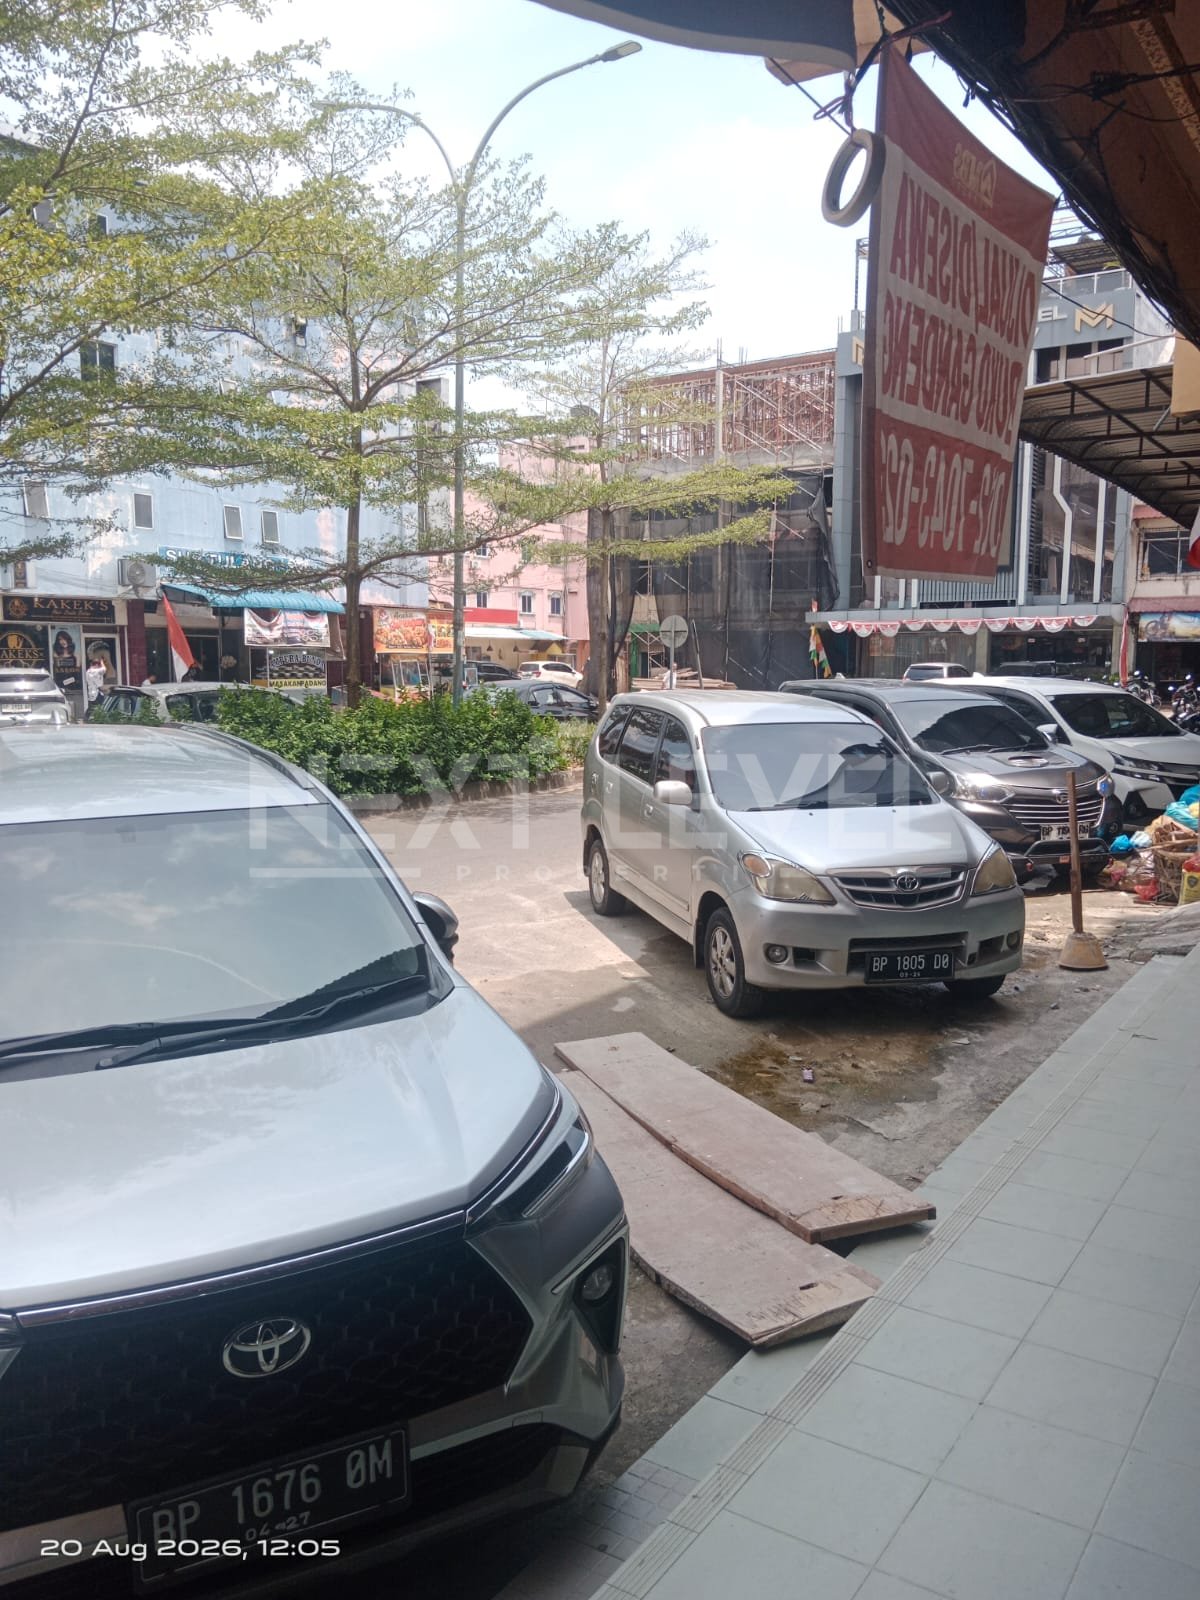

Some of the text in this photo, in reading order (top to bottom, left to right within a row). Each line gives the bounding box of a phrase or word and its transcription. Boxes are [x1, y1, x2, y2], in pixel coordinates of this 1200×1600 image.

[33, 597, 109, 612] KAKEK'S
[872, 956, 888, 972] BP
[897, 954, 925, 971] 1805
[153, 1500, 200, 1552] BP
[231, 1463, 322, 1524] 1676
